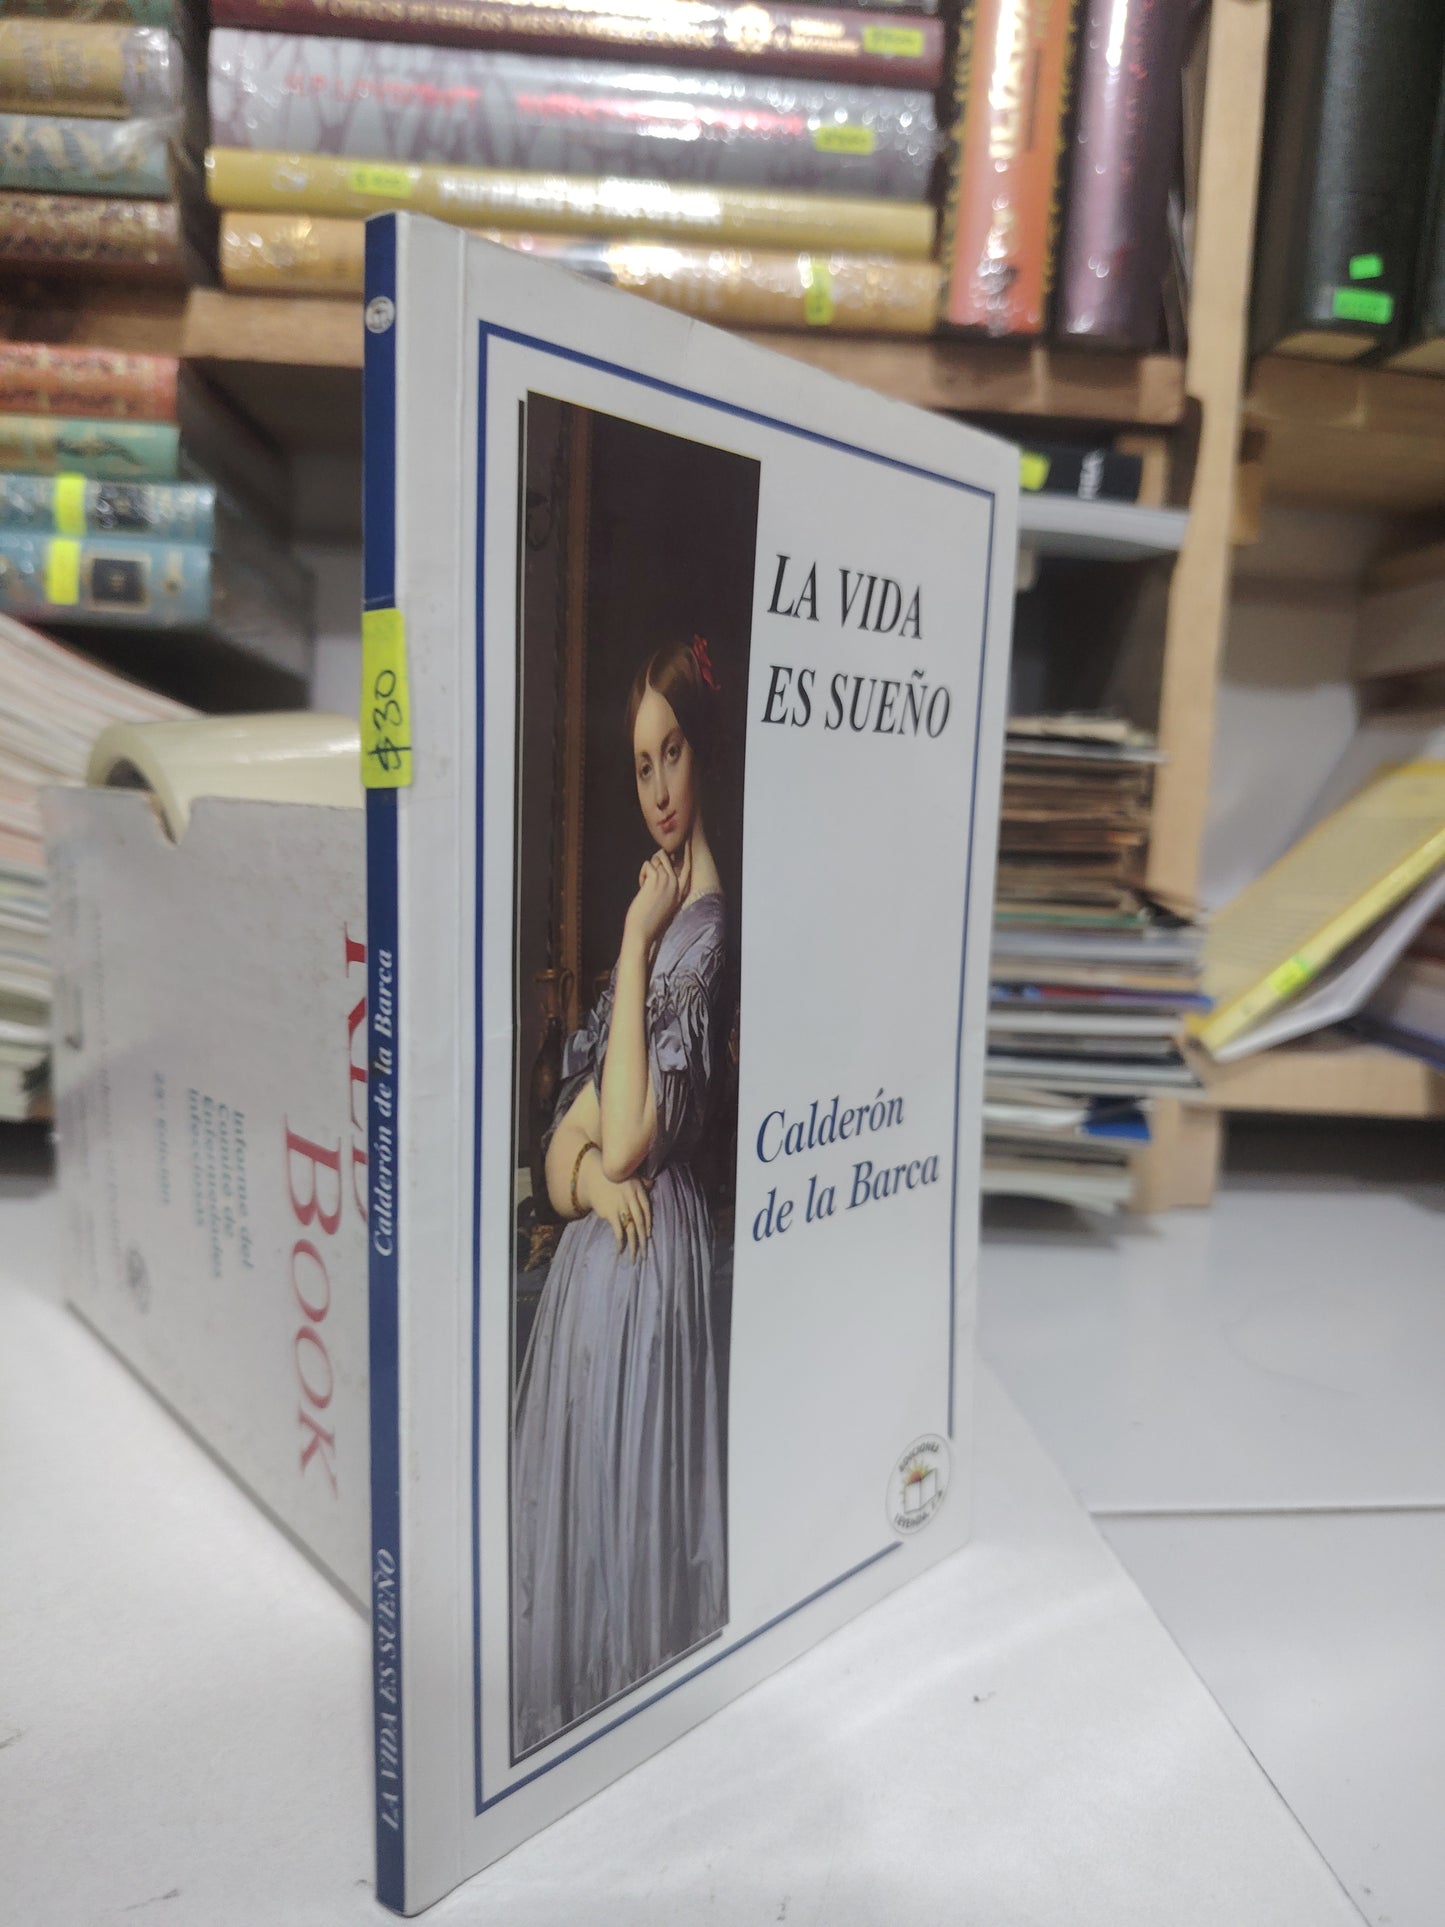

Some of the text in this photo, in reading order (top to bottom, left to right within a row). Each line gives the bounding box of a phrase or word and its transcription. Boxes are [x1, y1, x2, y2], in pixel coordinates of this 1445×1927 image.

[767, 554, 922, 640] LA VIDA
[368, 670, 411, 771] $30
[761, 665, 951, 739] ES SUEÑO
[373, 948, 393, 1257] Calderón de la Barca
[756, 1087, 904, 1163] Calderón
[752, 1154, 940, 1242] de la Barca
